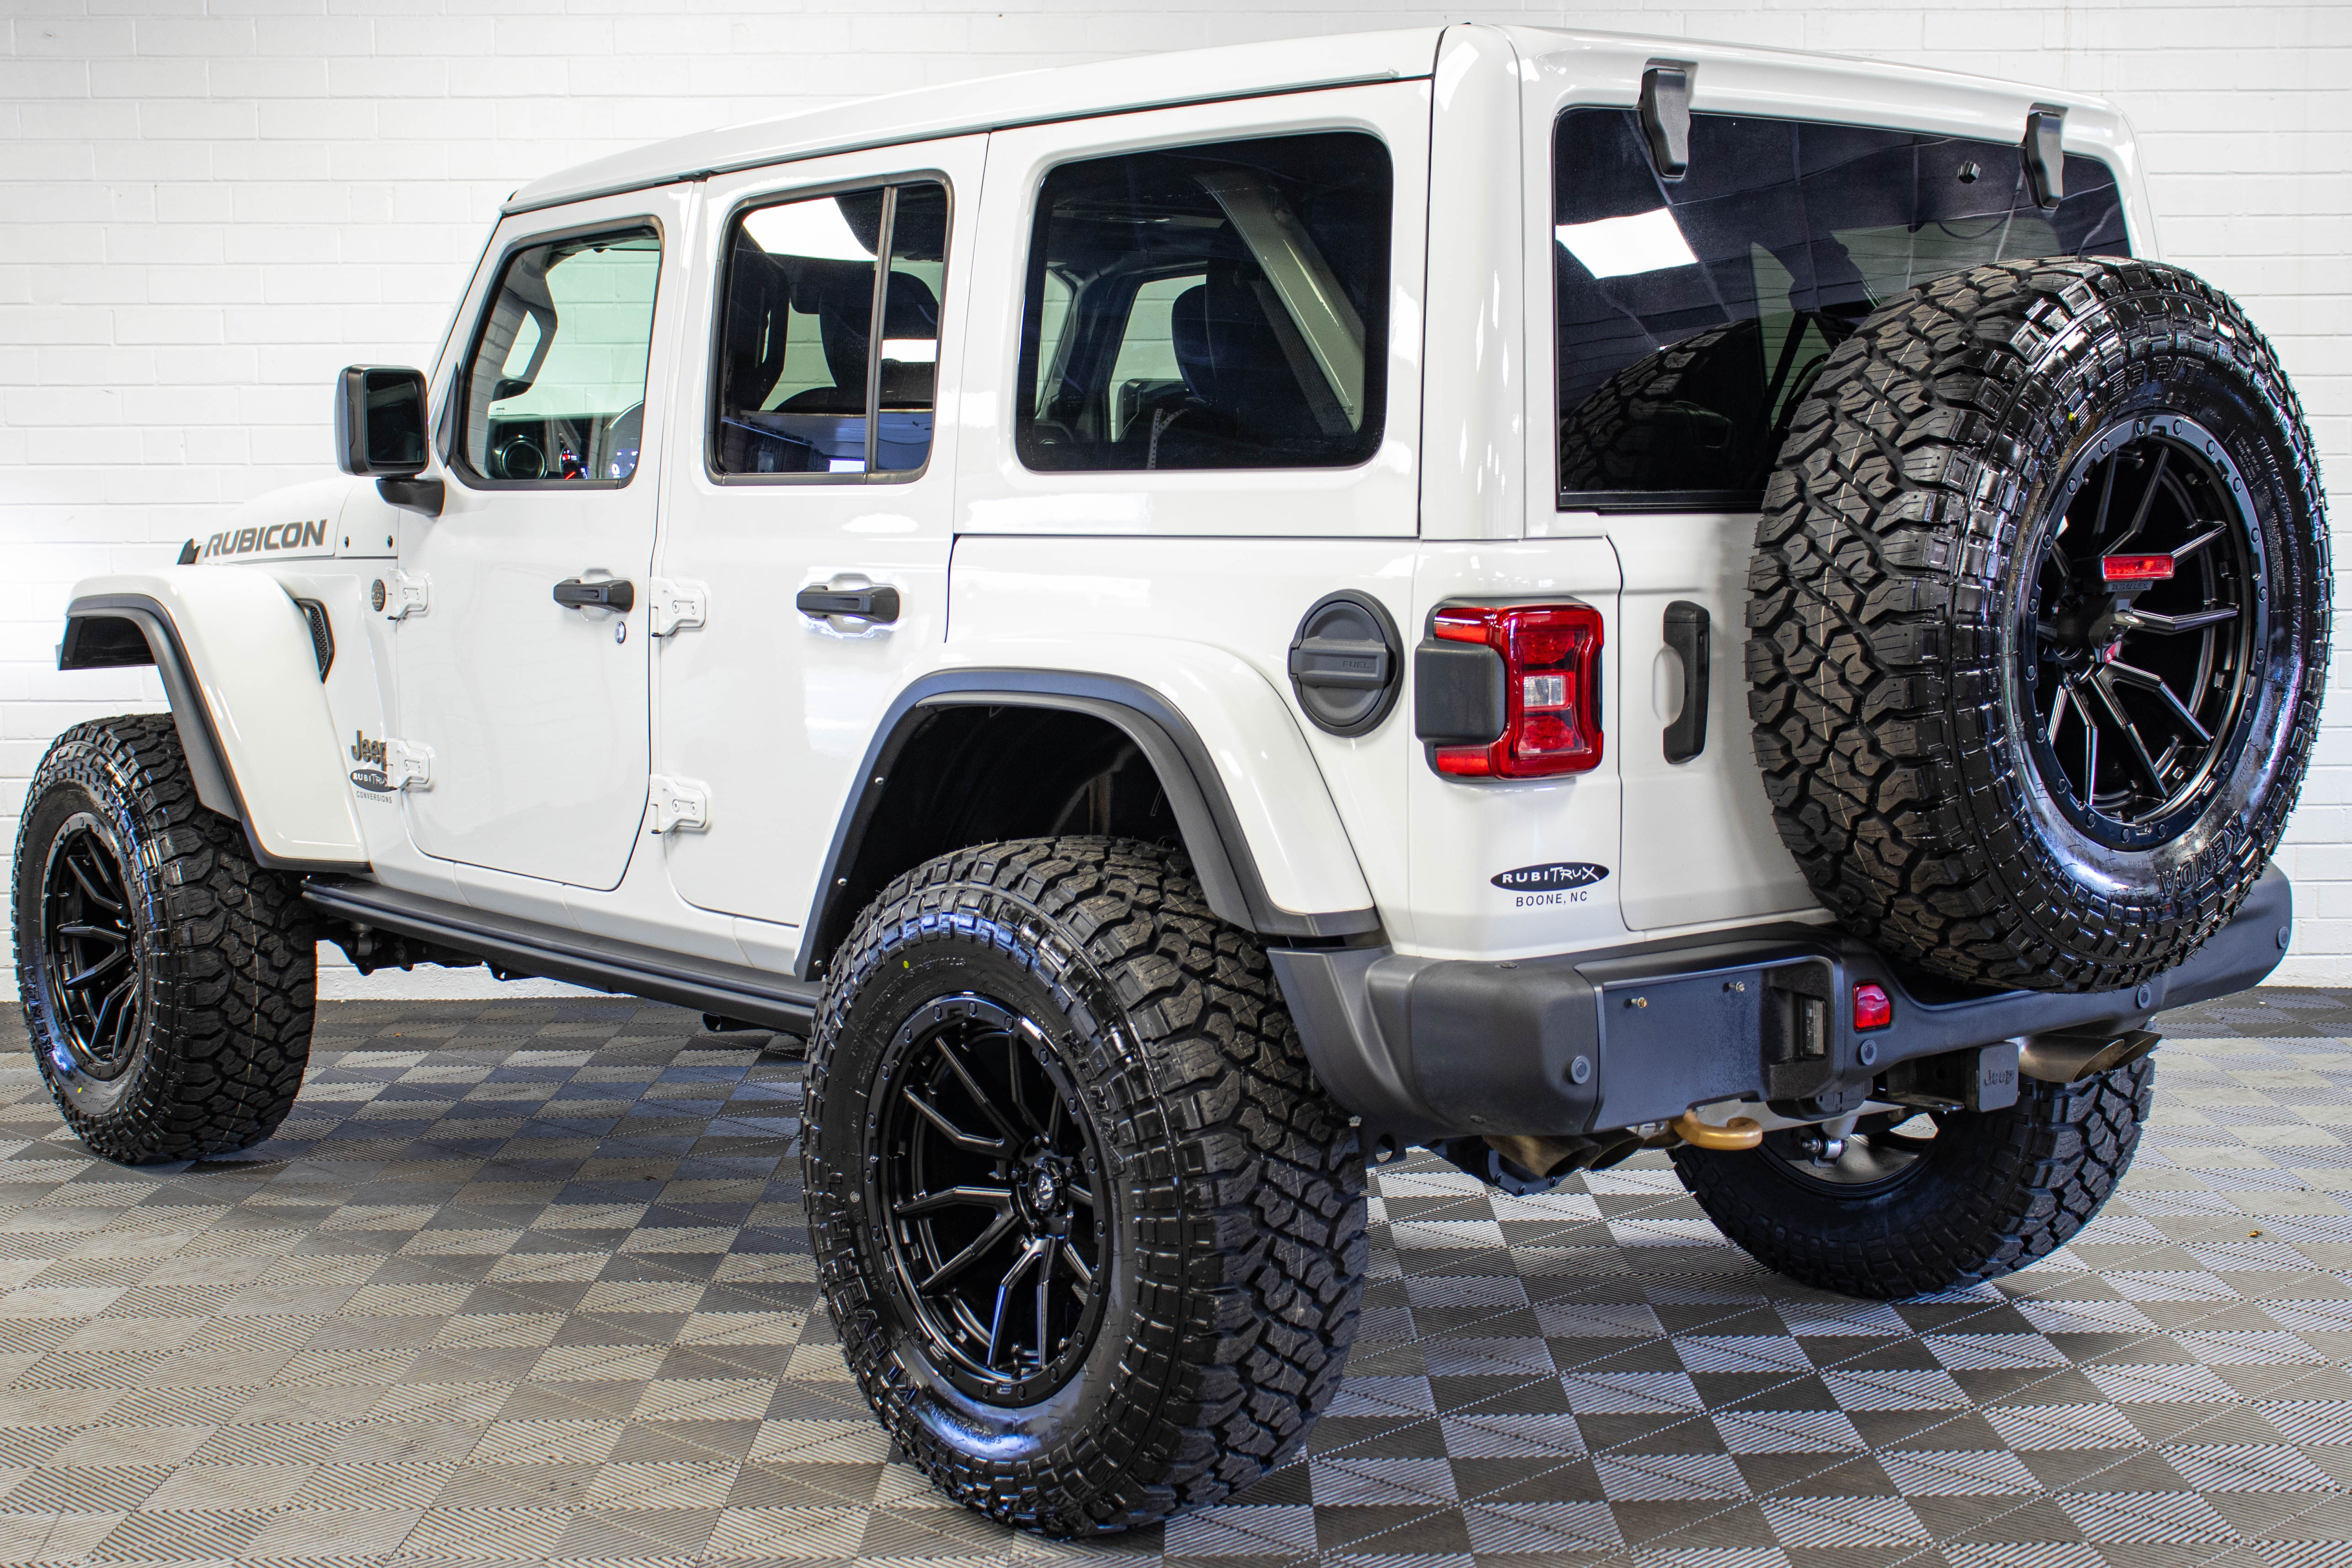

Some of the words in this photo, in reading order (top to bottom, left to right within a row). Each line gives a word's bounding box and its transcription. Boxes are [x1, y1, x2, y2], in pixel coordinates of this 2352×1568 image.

[204, 519, 328, 558] RUBICON
[1343, 660, 1371, 669] FUEL
[356, 790, 393, 804] CONVERSIONS
[2157, 809, 2246, 897] KENDA
[1502, 866, 1599, 883] RUBITRUX
[1516, 893, 1566, 907] BOONE,
[1570, 891, 1587, 902] NC
[1984, 1069, 2014, 1086] Jeep
